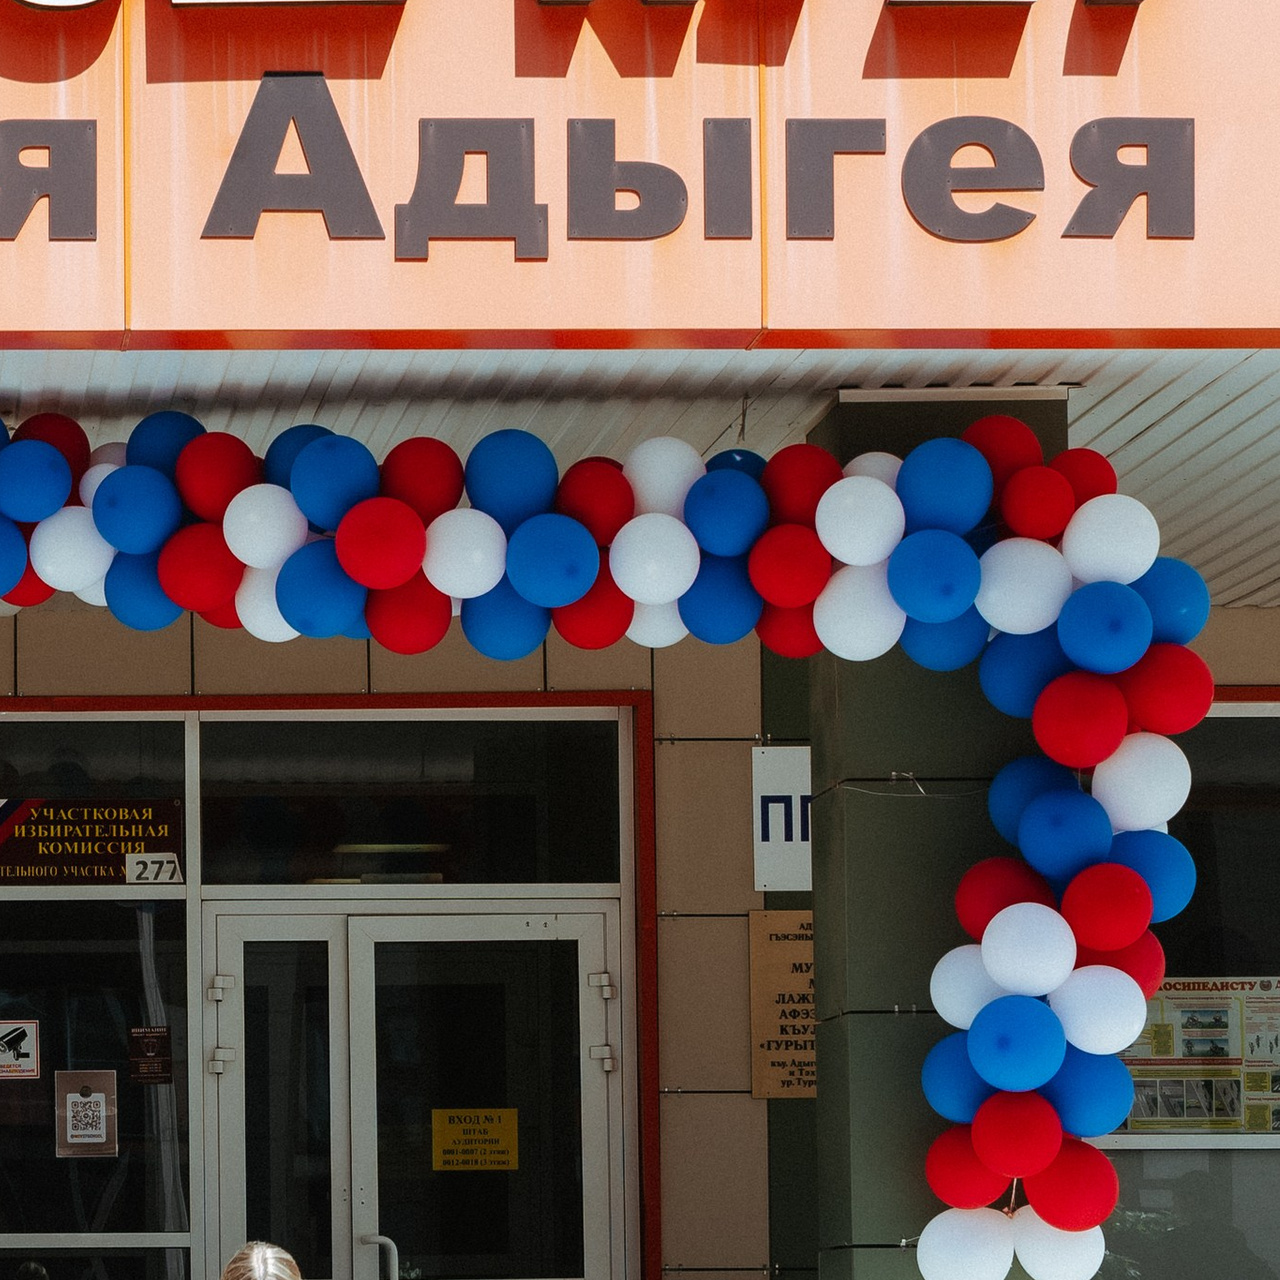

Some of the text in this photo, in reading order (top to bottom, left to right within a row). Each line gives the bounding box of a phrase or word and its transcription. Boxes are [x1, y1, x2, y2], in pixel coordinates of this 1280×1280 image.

[201, 71, 1195, 262] Адыгея
[30, 807, 153, 820] УЧАСТКОВАЯ
[14, 824, 169, 837] ИЗБИРАТЕЛЬНАЯ
[38, 841, 146, 854] КОМИССИЯ
[63, 865, 115, 877] УЧАСТКА
[135, 859, 177, 881] 277
[448, 1115, 481, 1125] ВХОД
[483, 1115, 494, 1124] №
[462, 1128, 489, 1136] ШТАБ
[451, 1138, 500, 1146] АУДИТОРИИ
